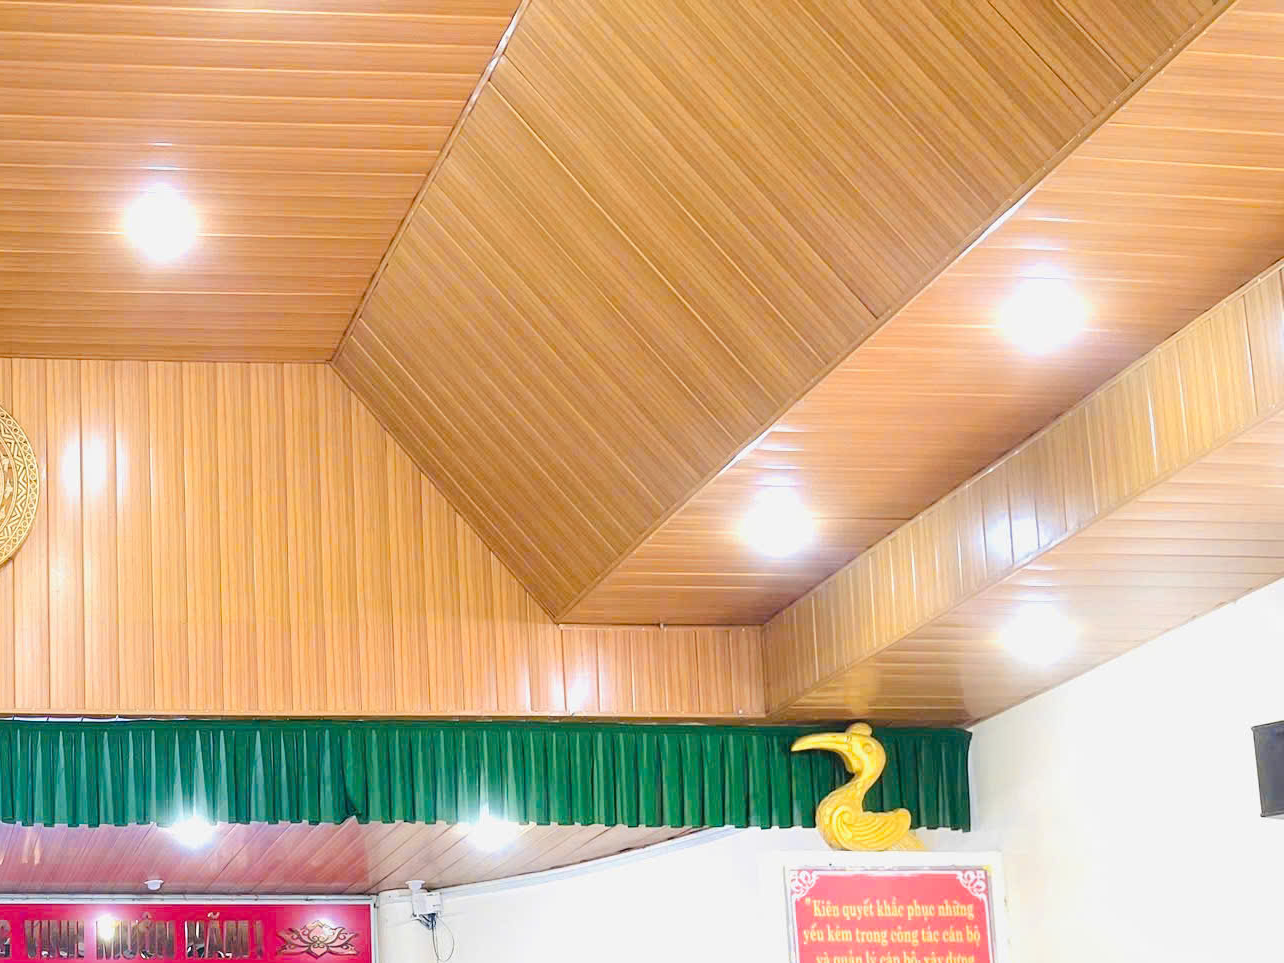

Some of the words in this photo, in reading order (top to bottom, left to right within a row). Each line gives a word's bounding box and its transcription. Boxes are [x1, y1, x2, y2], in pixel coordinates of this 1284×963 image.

[842, 898, 874, 921] quyết
[876, 898, 903, 918] khắc
[907, 901, 935, 921] phục
[938, 900, 974, 921] những
[25, 918, 85, 960] VINH
[96, 913, 176, 960] MUÔN
[803, 923, 824, 944] yếu
[827, 925, 852, 942] kém
[855, 927, 888, 946] trong
[890, 926, 919, 946] công
[921, 925, 939, 943] tác
[942, 926, 962, 943] cán
[965, 925, 981, 946] bộ
